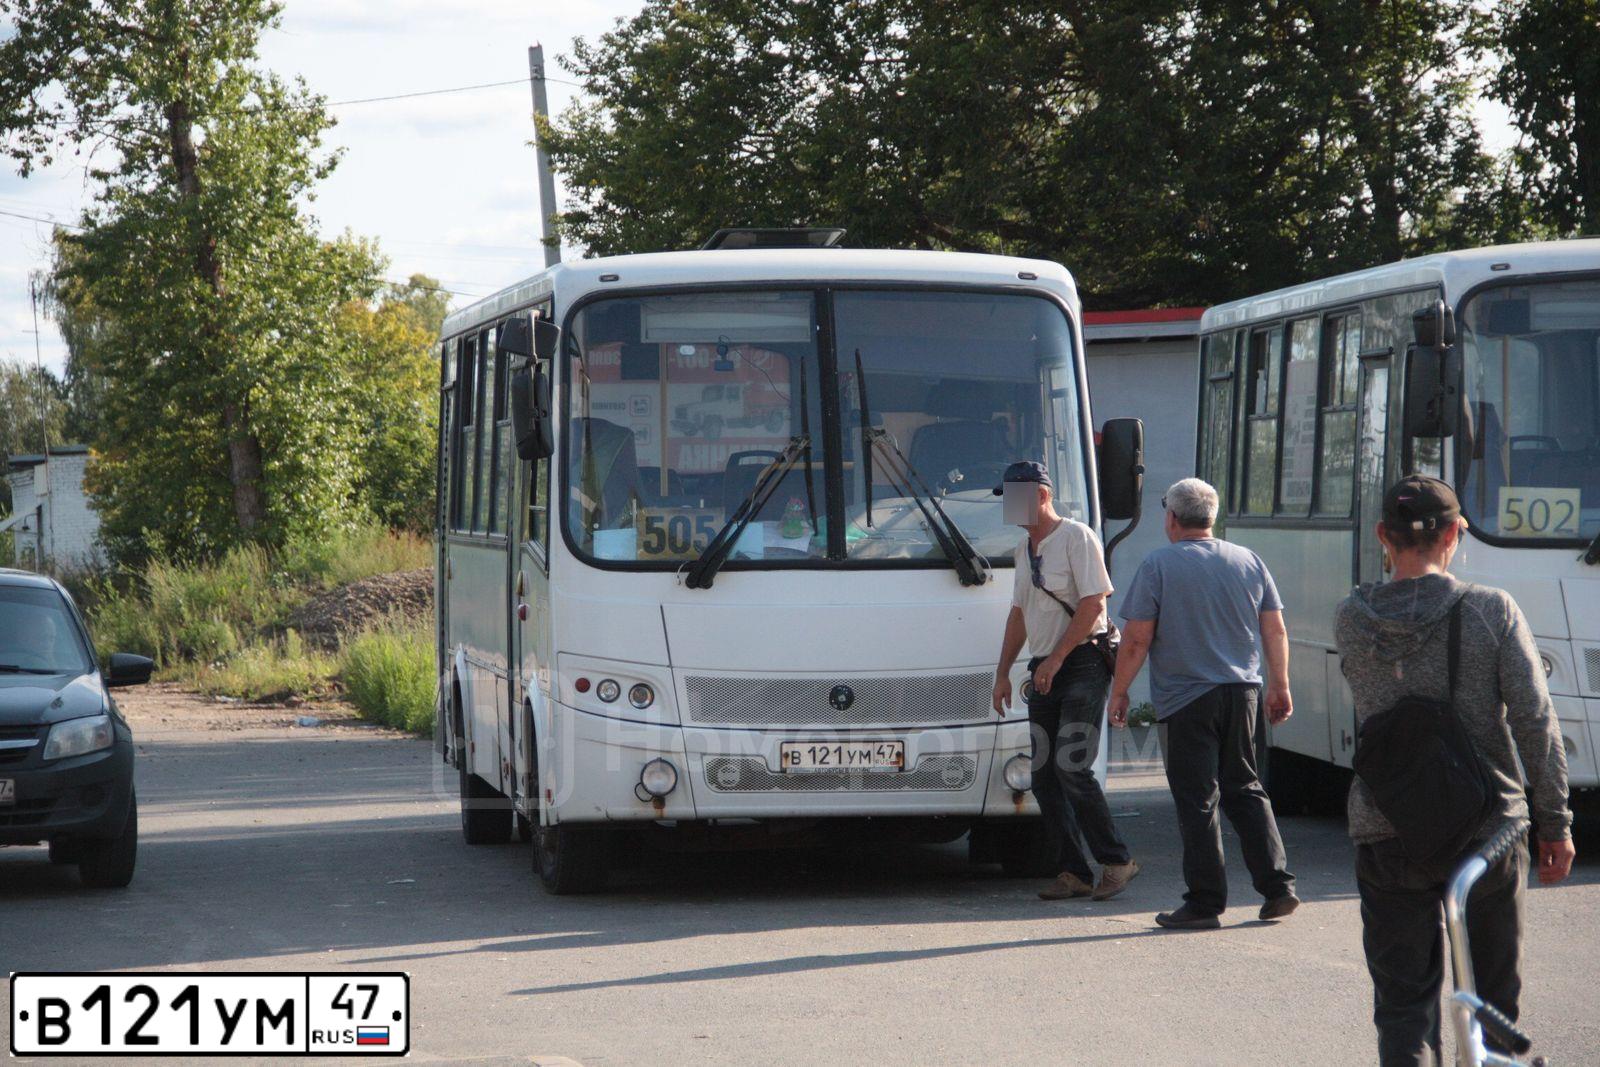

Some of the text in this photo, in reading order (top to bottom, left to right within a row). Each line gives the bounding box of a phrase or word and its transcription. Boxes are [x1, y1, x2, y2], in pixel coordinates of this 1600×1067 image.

[1503, 498, 1574, 532] 502
[643, 515, 717, 554] 505
[876, 744, 895, 759] 47
